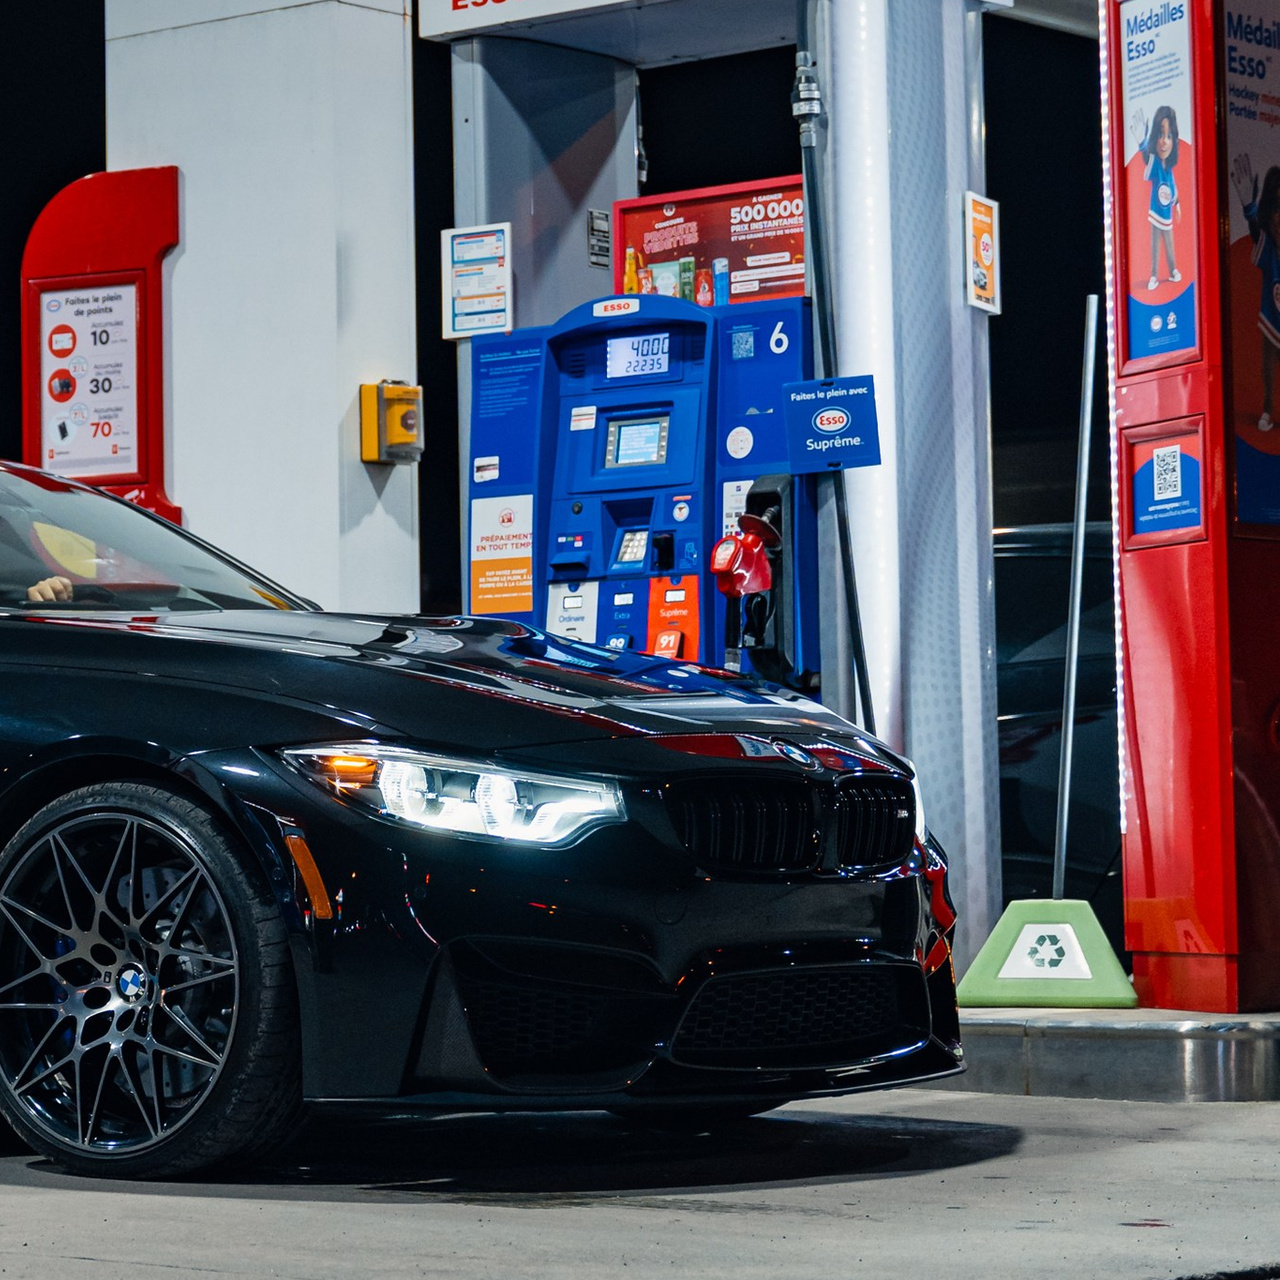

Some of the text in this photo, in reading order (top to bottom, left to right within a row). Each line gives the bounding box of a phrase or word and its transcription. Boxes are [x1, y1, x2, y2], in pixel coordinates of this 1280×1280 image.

[1126, 2, 1184, 38] Médailles
[1127, 39, 1155, 62] Esso
[1227, 45, 1266, 80] Esso
[730, 223, 749, 233] PRIX
[64, 293, 122, 305] Faites le plein
[74, 306, 113, 317] de points
[603, 302, 630, 312] ESSO
[90, 329, 110, 346] 10
[769, 321, 789, 354] 6
[89, 377, 112, 394] 30
[791, 387, 868, 401] Faites le plein avec
[819, 415, 845, 426] Esso
[89, 421, 112, 438] 70
[806, 435, 861, 452] Suprême
[480, 533, 533, 542] PRÉPAIEMENT
[489, 543, 508, 551] TOUT
[511, 541, 533, 550] TEMP
[558, 607, 688, 623] Ordinaire Extra Suprême
[660, 634, 675, 648] 91
